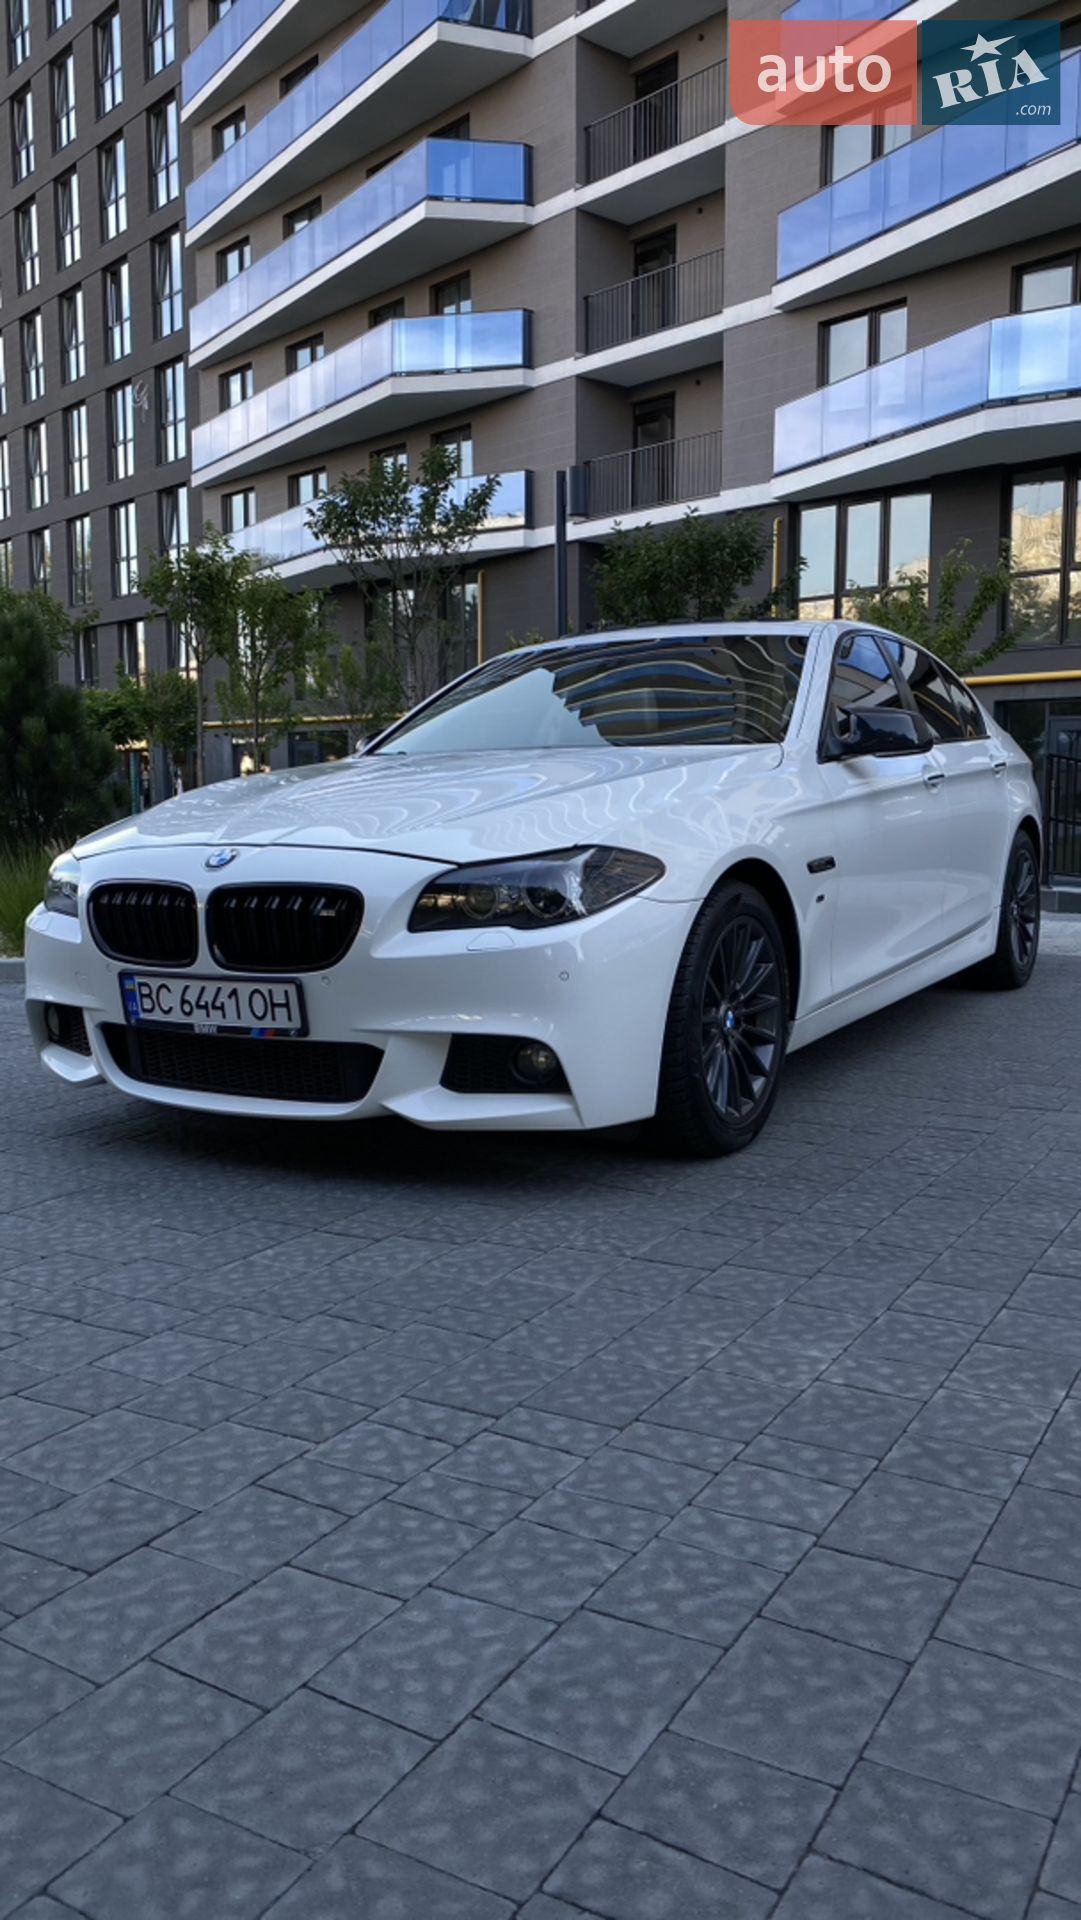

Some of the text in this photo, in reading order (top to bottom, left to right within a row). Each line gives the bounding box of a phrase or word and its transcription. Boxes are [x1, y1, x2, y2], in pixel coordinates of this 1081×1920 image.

[137, 981, 292, 1022] BC 6441 OH
